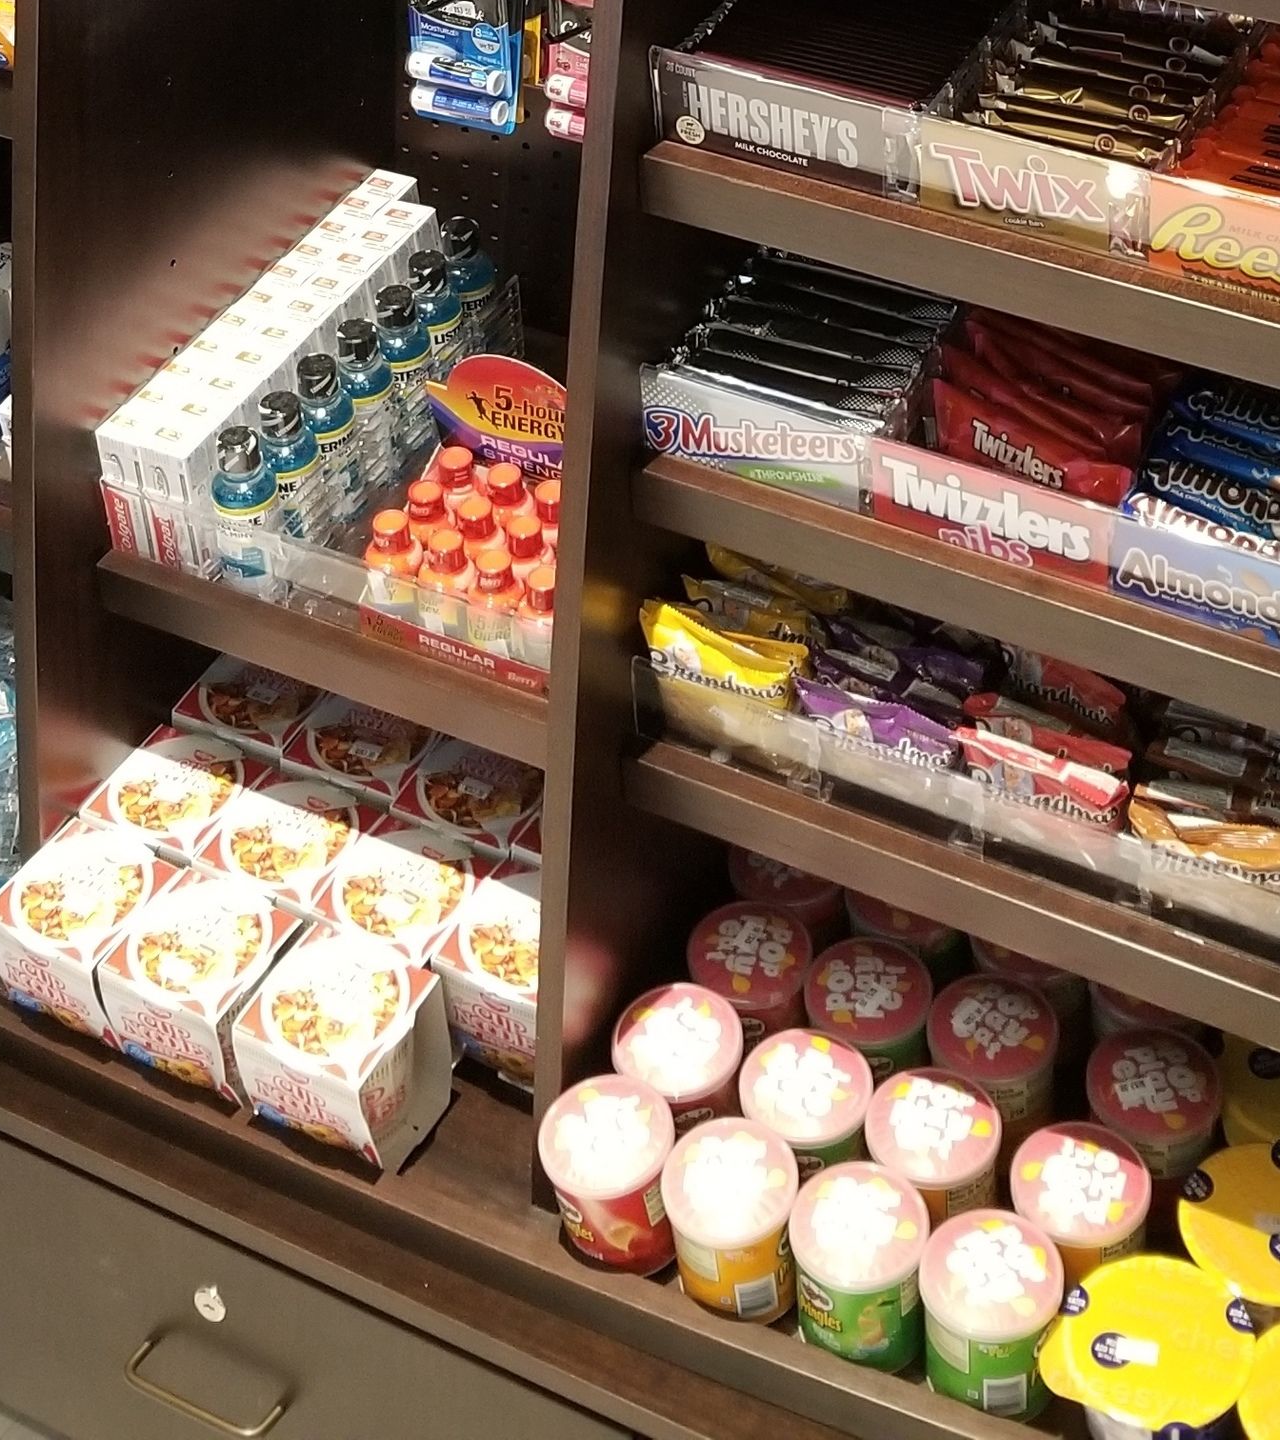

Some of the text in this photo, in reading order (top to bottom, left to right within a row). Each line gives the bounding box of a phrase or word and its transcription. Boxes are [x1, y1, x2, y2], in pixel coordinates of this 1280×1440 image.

[687, 81, 858, 169] HERSHEY'S
[735, 141, 808, 167] MILK CHOCOLATE
[930, 143, 1106, 223] Twix
[1003, 216, 1045, 229] cookie bars
[1228, 225, 1255, 240] MILK
[647, 409, 856, 461] 3 Musketeers
[972, 419, 1064, 489] Twizzlers
[882, 455, 1090, 560] Twizzlers
[938, 524, 1035, 567] nibs
[419, 634, 496, 668] REGULAR
[650, 646, 786, 699] Grandma's
[508, 671, 538, 688] Berry
[800, 1301, 843, 1333] Pringles
